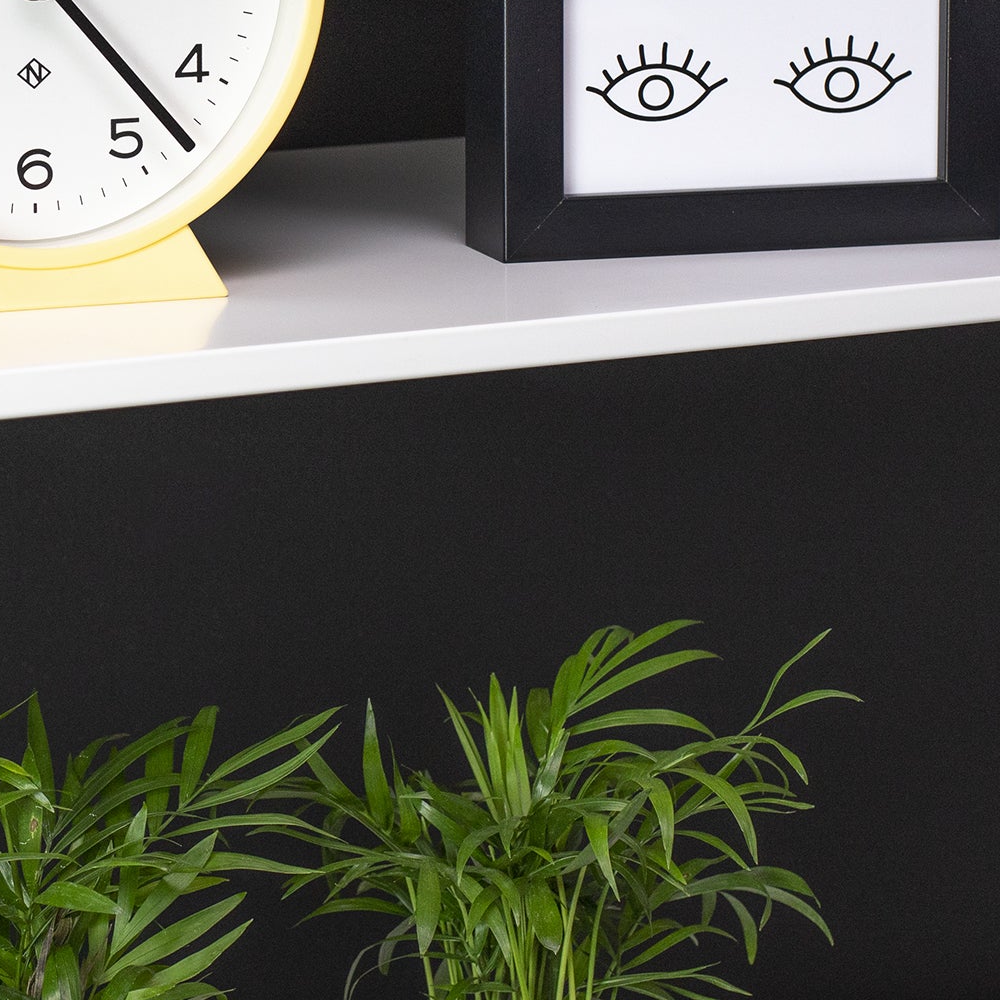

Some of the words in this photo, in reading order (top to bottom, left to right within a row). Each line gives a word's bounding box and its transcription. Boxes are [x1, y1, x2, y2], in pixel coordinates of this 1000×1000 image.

[174, 43, 210, 83] 4
[108, 117, 144, 159] 5
[16, 148, 54, 191] 6
